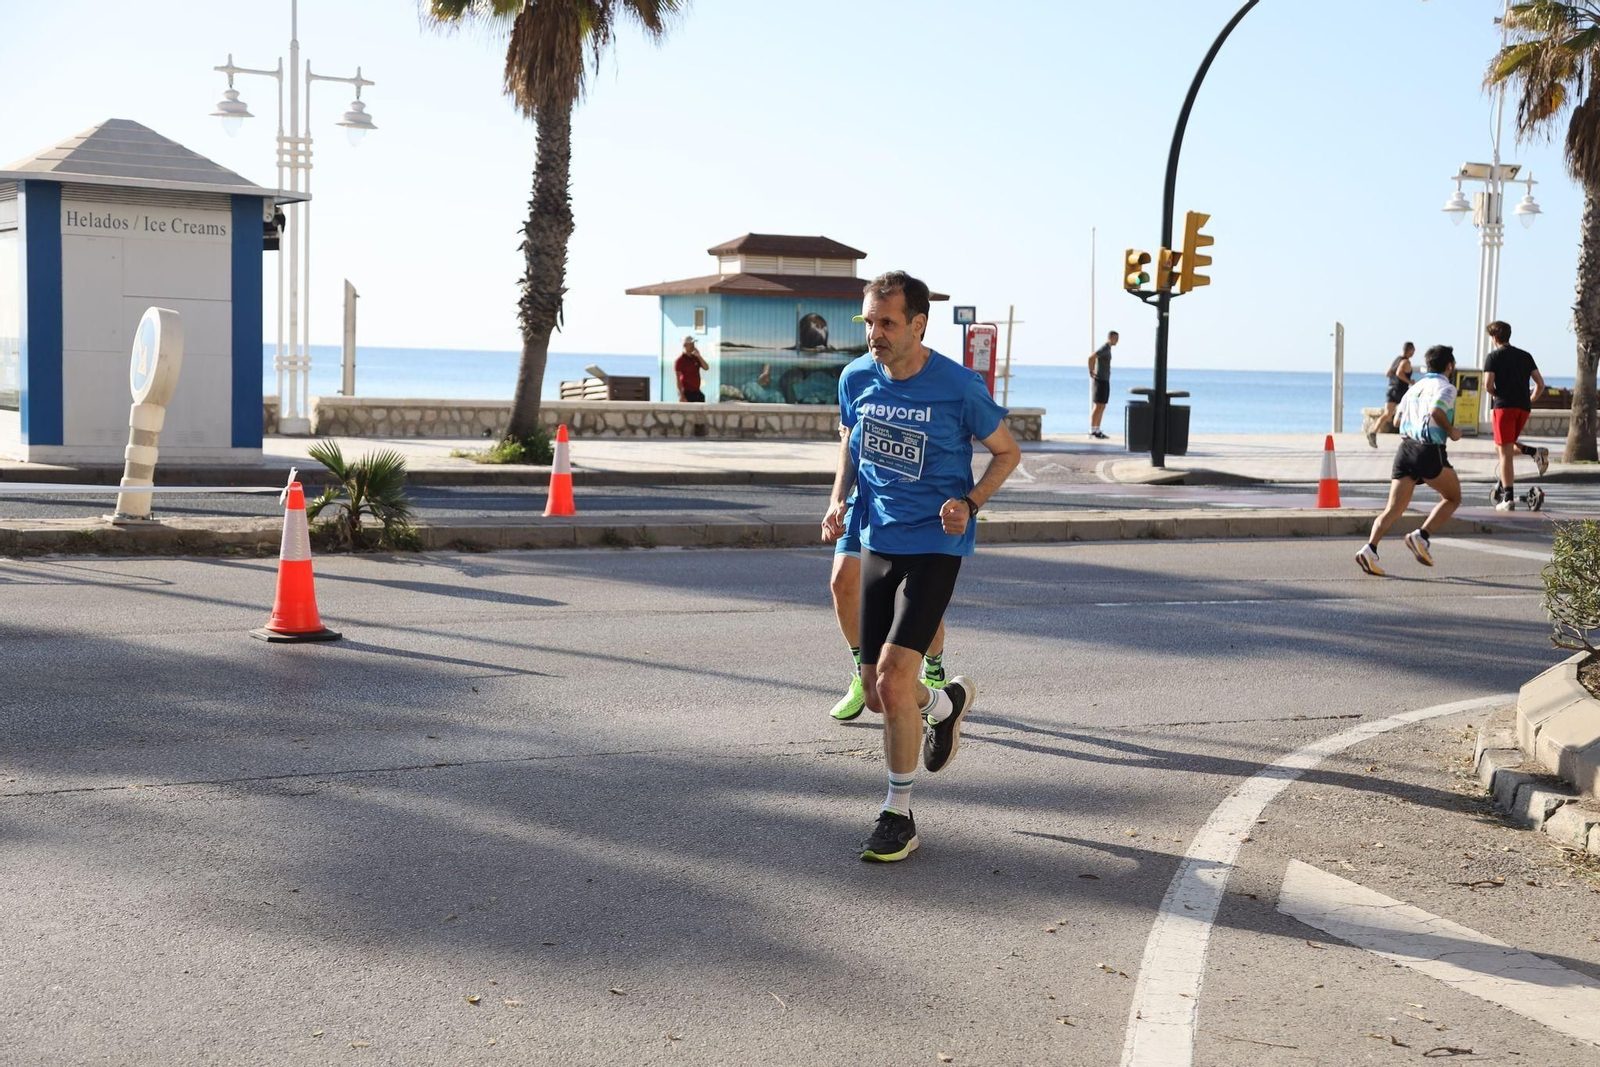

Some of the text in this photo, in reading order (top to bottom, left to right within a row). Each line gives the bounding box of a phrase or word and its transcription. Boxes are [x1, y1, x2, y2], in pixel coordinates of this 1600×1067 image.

[66, 211, 227, 236] Helados / Ice Creams
[861, 403, 931, 422] mayoral
[868, 435, 916, 460] 2006
